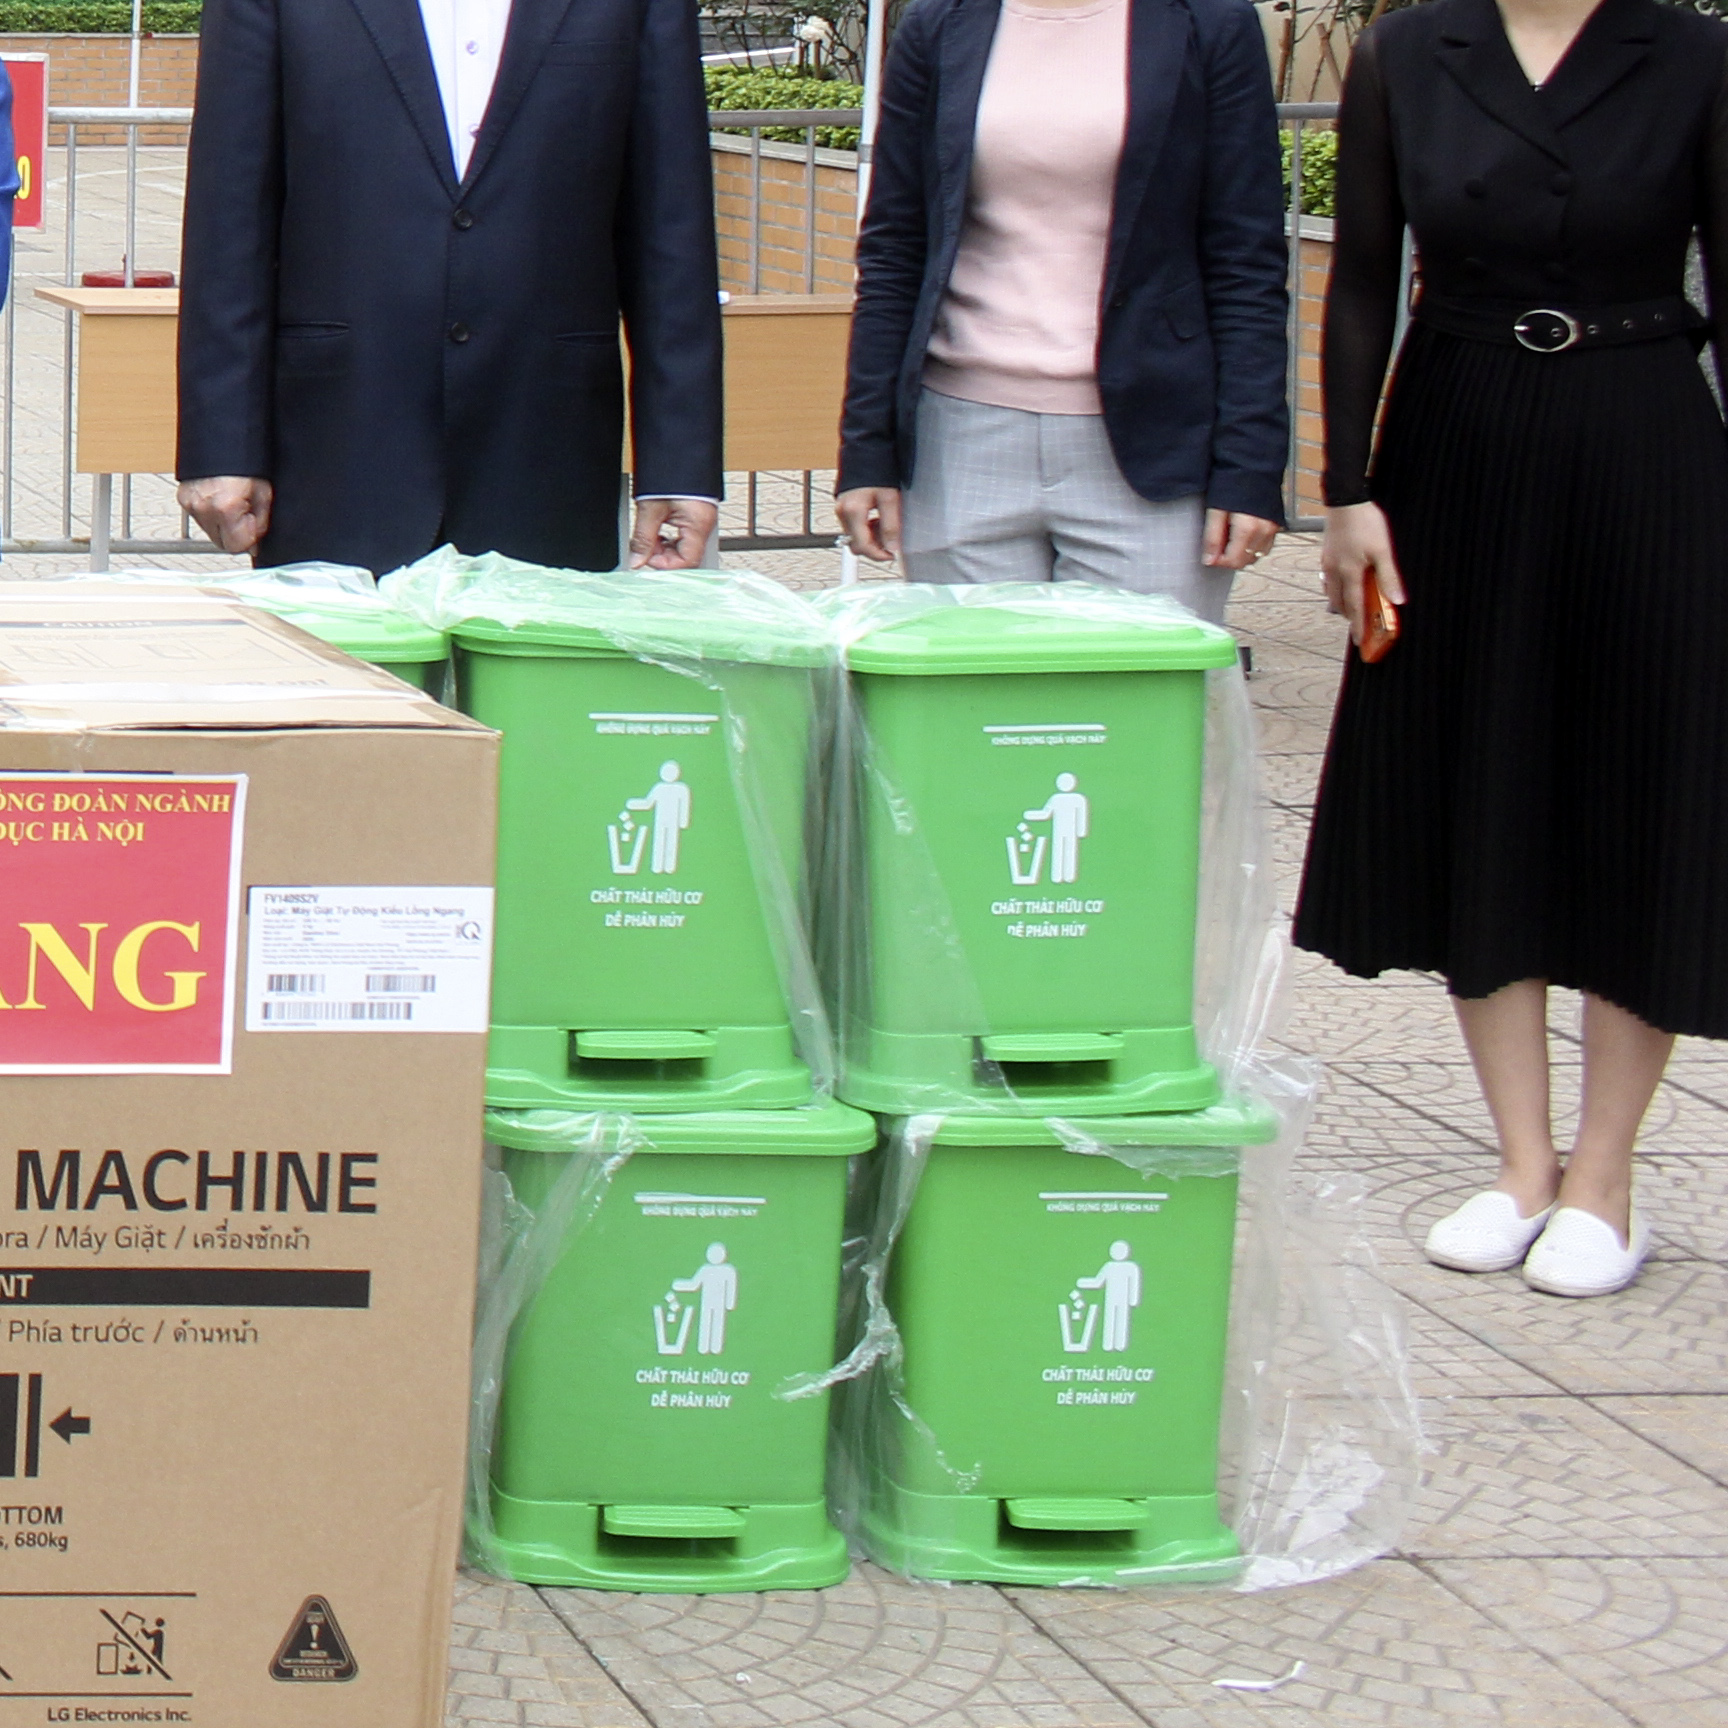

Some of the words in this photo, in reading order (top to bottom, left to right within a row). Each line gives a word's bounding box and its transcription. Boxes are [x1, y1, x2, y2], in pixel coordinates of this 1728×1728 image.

[52, 788, 129, 813] ĐOÀN
[134, 788, 231, 813] NGÀNH
[50, 816, 90, 842] HÀ
[96, 820, 144, 847] NỘI
[14, 1151, 380, 1215] MACHINE
[55, 1225, 109, 1256] Máy
[115, 1225, 168, 1255] Giặt
[8, 1319, 64, 1345] Phía
[70, 1319, 146, 1345] trước
[14, 1531, 69, 1553] 680kg
[292, 1669, 335, 1677] DANGER
[47, 1707, 68, 1723] LG
[72, 1706, 155, 1723] Electronics
[160, 1707, 193, 1723] Inc.
